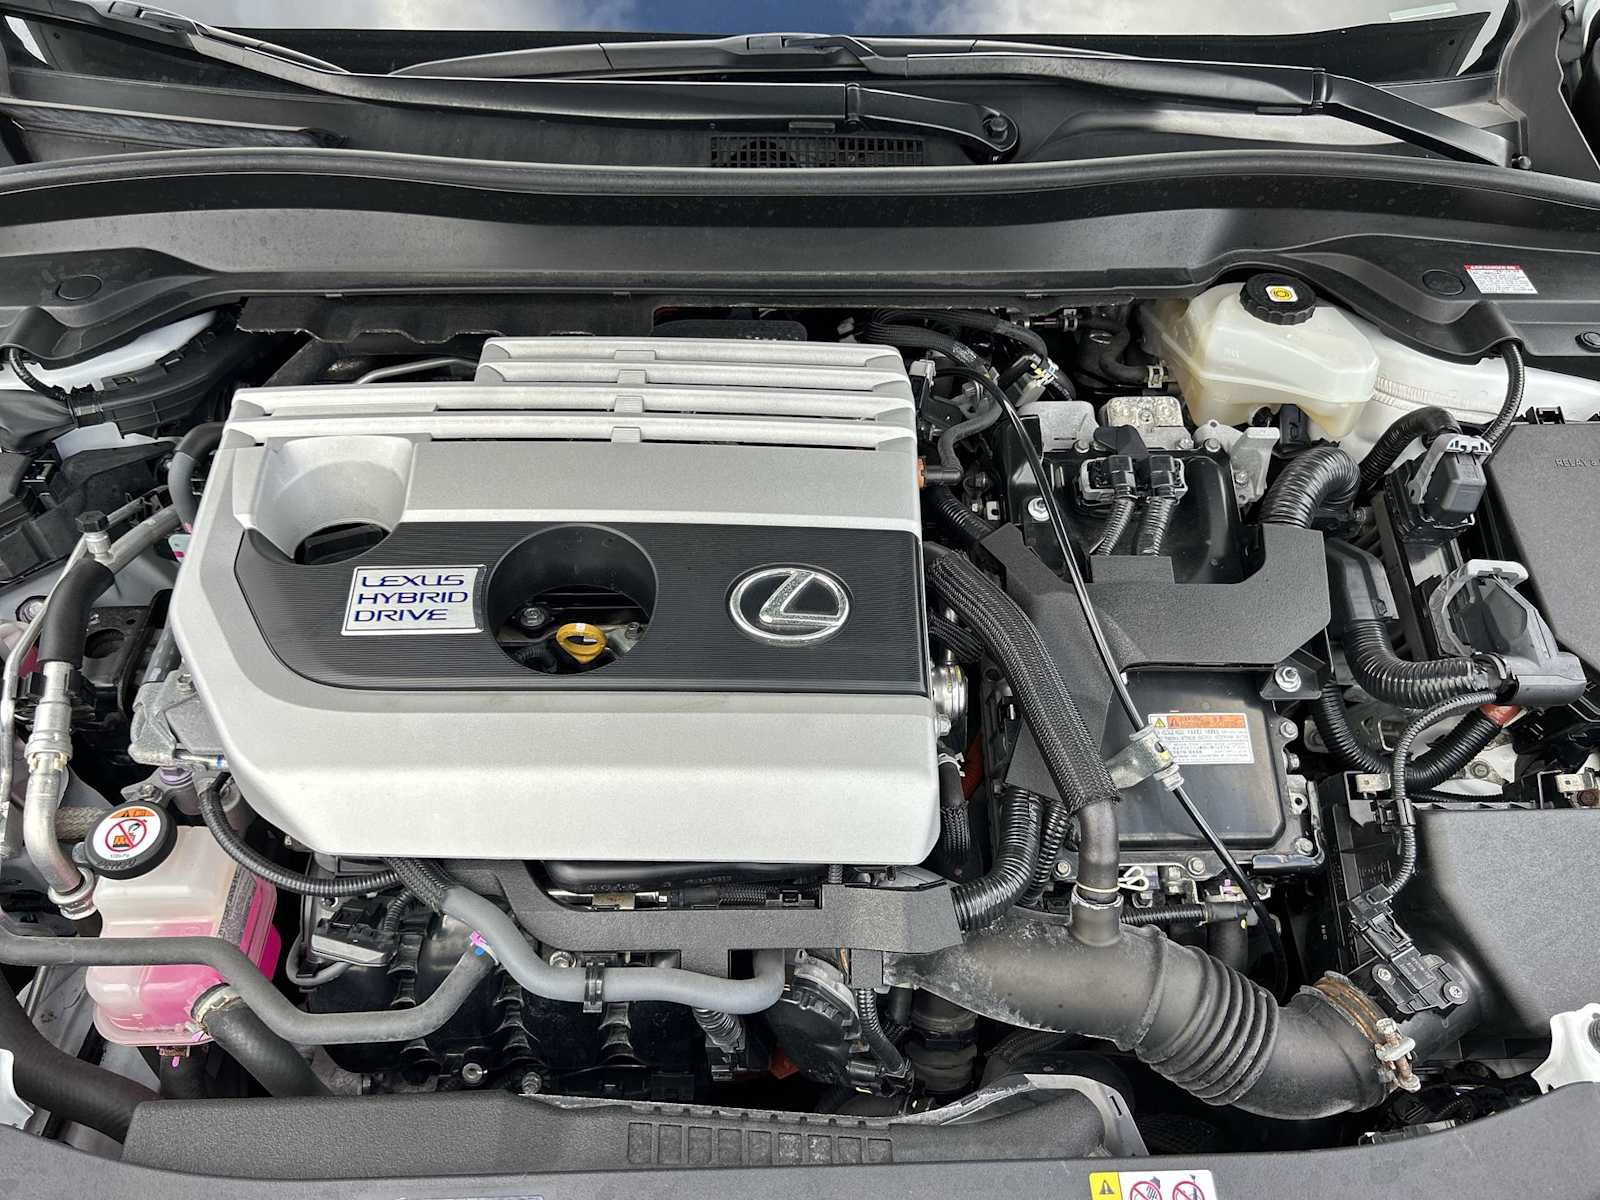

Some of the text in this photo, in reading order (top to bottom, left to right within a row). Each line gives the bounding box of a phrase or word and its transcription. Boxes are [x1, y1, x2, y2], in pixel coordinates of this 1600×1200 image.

[1554, 458, 1587, 468] RELAY
[361, 575, 465, 587] LEXUS
[358, 592, 468, 604] HYBRID
[355, 609, 448, 621] DRIVE
